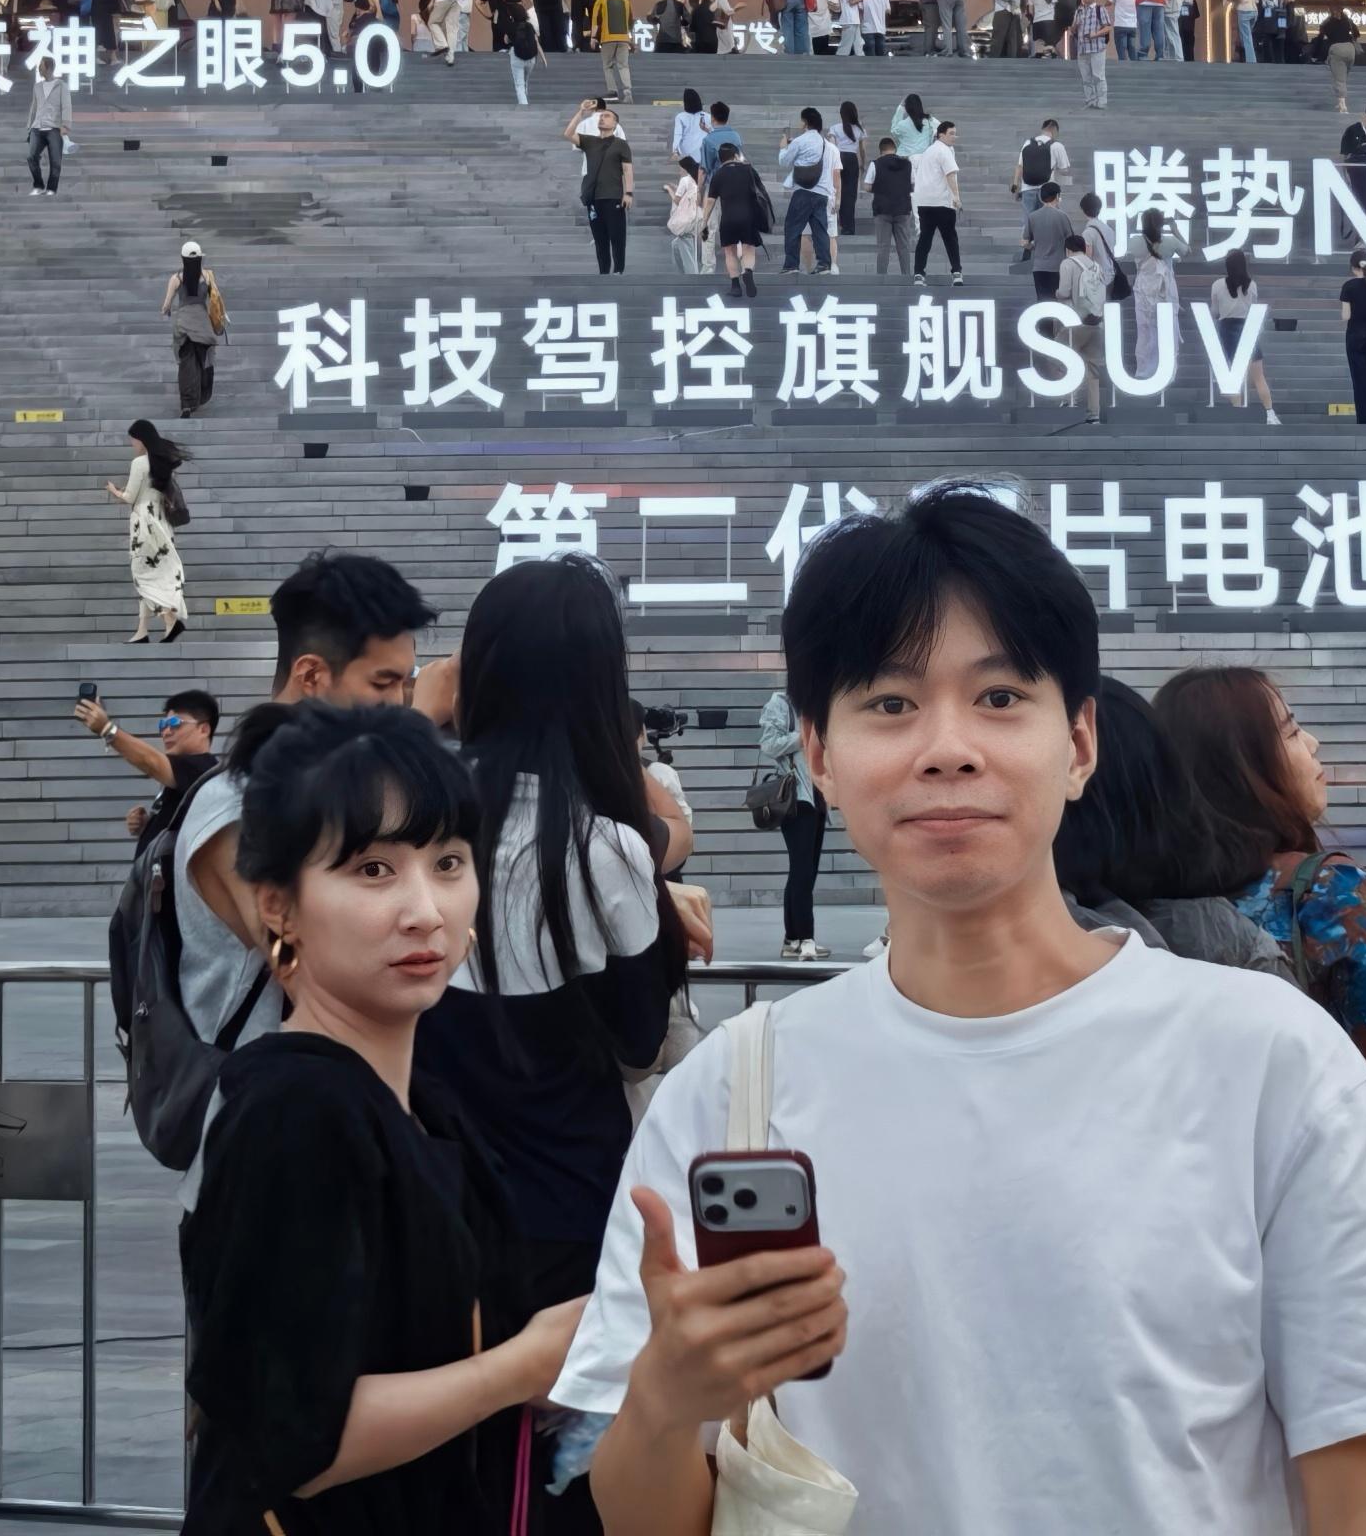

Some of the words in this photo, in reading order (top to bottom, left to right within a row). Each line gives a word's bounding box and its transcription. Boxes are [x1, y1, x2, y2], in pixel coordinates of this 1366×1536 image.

[273, 294, 1269, 409] 科技驾控旗舰SUV
